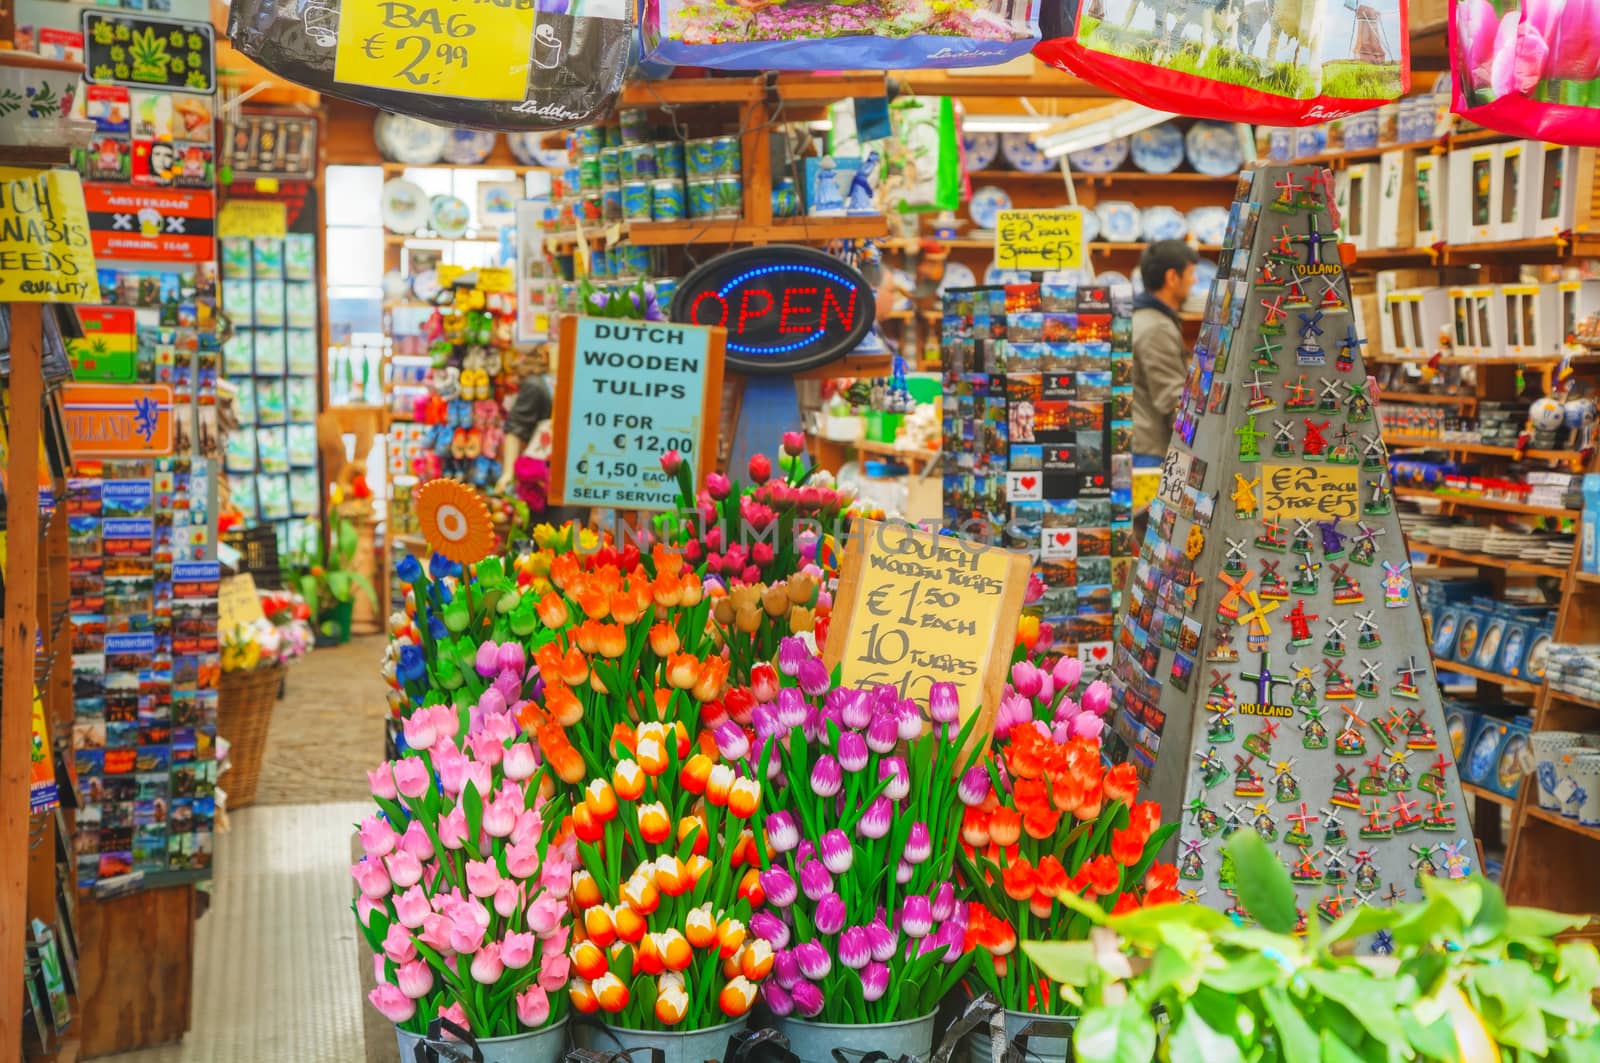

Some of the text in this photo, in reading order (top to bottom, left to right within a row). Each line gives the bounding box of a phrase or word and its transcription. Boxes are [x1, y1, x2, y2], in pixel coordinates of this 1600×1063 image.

[1297, 263, 1342, 276] OLLAND
[690, 286, 858, 335] OPEN
[594, 323, 685, 345] DUTCH
[583, 351, 699, 373] WOODEN
[592, 378, 686, 400] TULIPS
[584, 412, 653, 430] 10 FOR
[633, 435, 692, 454] 12,00
[595, 461, 638, 479] 1,50
[573, 487, 611, 500] SELF
[896, 537, 982, 571] DUTCH
[920, 613, 977, 637] EACH
[1240, 703, 1293, 717] HOLLAND
